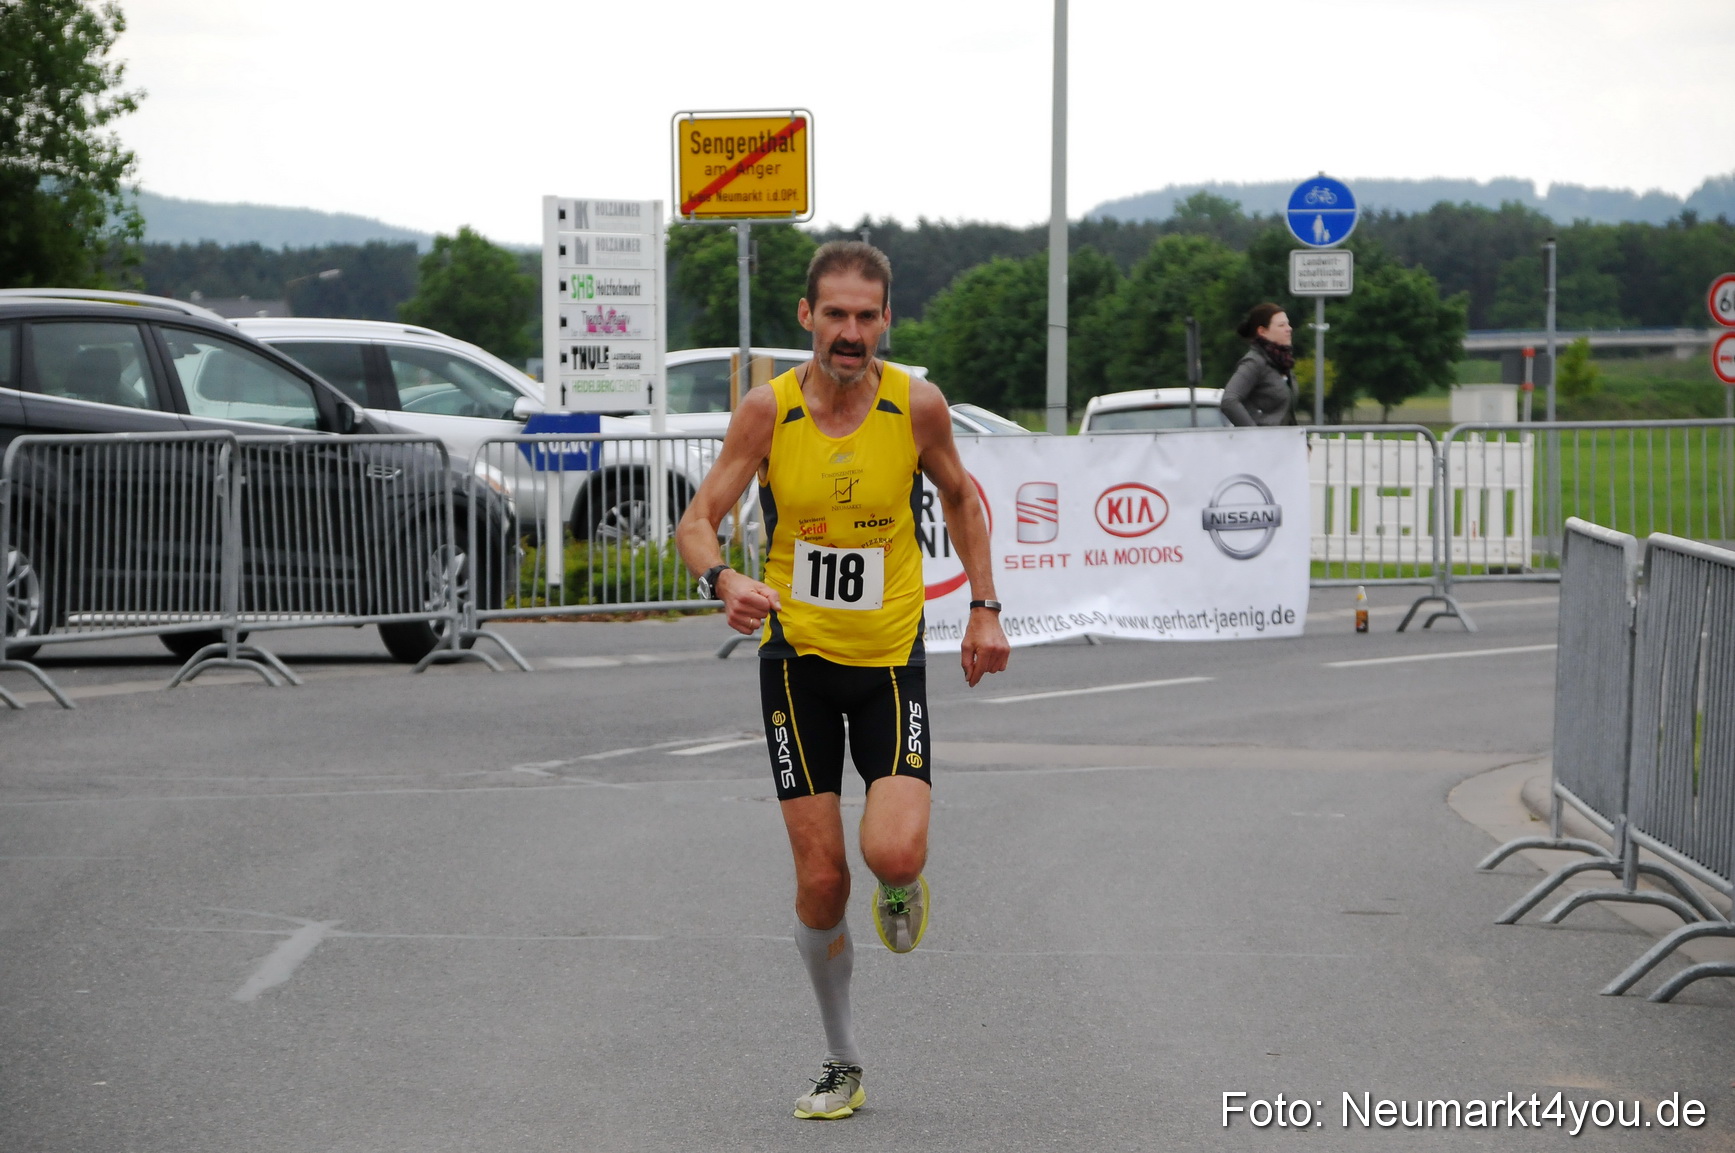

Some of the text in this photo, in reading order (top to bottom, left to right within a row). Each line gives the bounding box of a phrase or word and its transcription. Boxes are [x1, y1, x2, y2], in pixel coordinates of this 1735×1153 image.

[690, 129, 796, 160] Sengenthal
[705, 160, 782, 179] am Anger
[716, 189, 763, 202] Neumarkt
[595, 201, 640, 217] HOLZAMMER
[595, 236, 640, 253] HOLZAMMER
[571, 273, 595, 300] SHB
[571, 345, 609, 370] THULE
[1107, 496, 1155, 525] KIA
[1210, 510, 1274, 525] NISSAN
[800, 522, 827, 536] Seidl
[1004, 553, 1071, 569] SEAT
[1084, 545, 1184, 566] KIA MOTORS
[807, 550, 865, 603] 118
[1114, 603, 1296, 634] www.gerhart-jaenig.de
[908, 700, 923, 755] SKINS
[774, 726, 796, 789] SKINS
